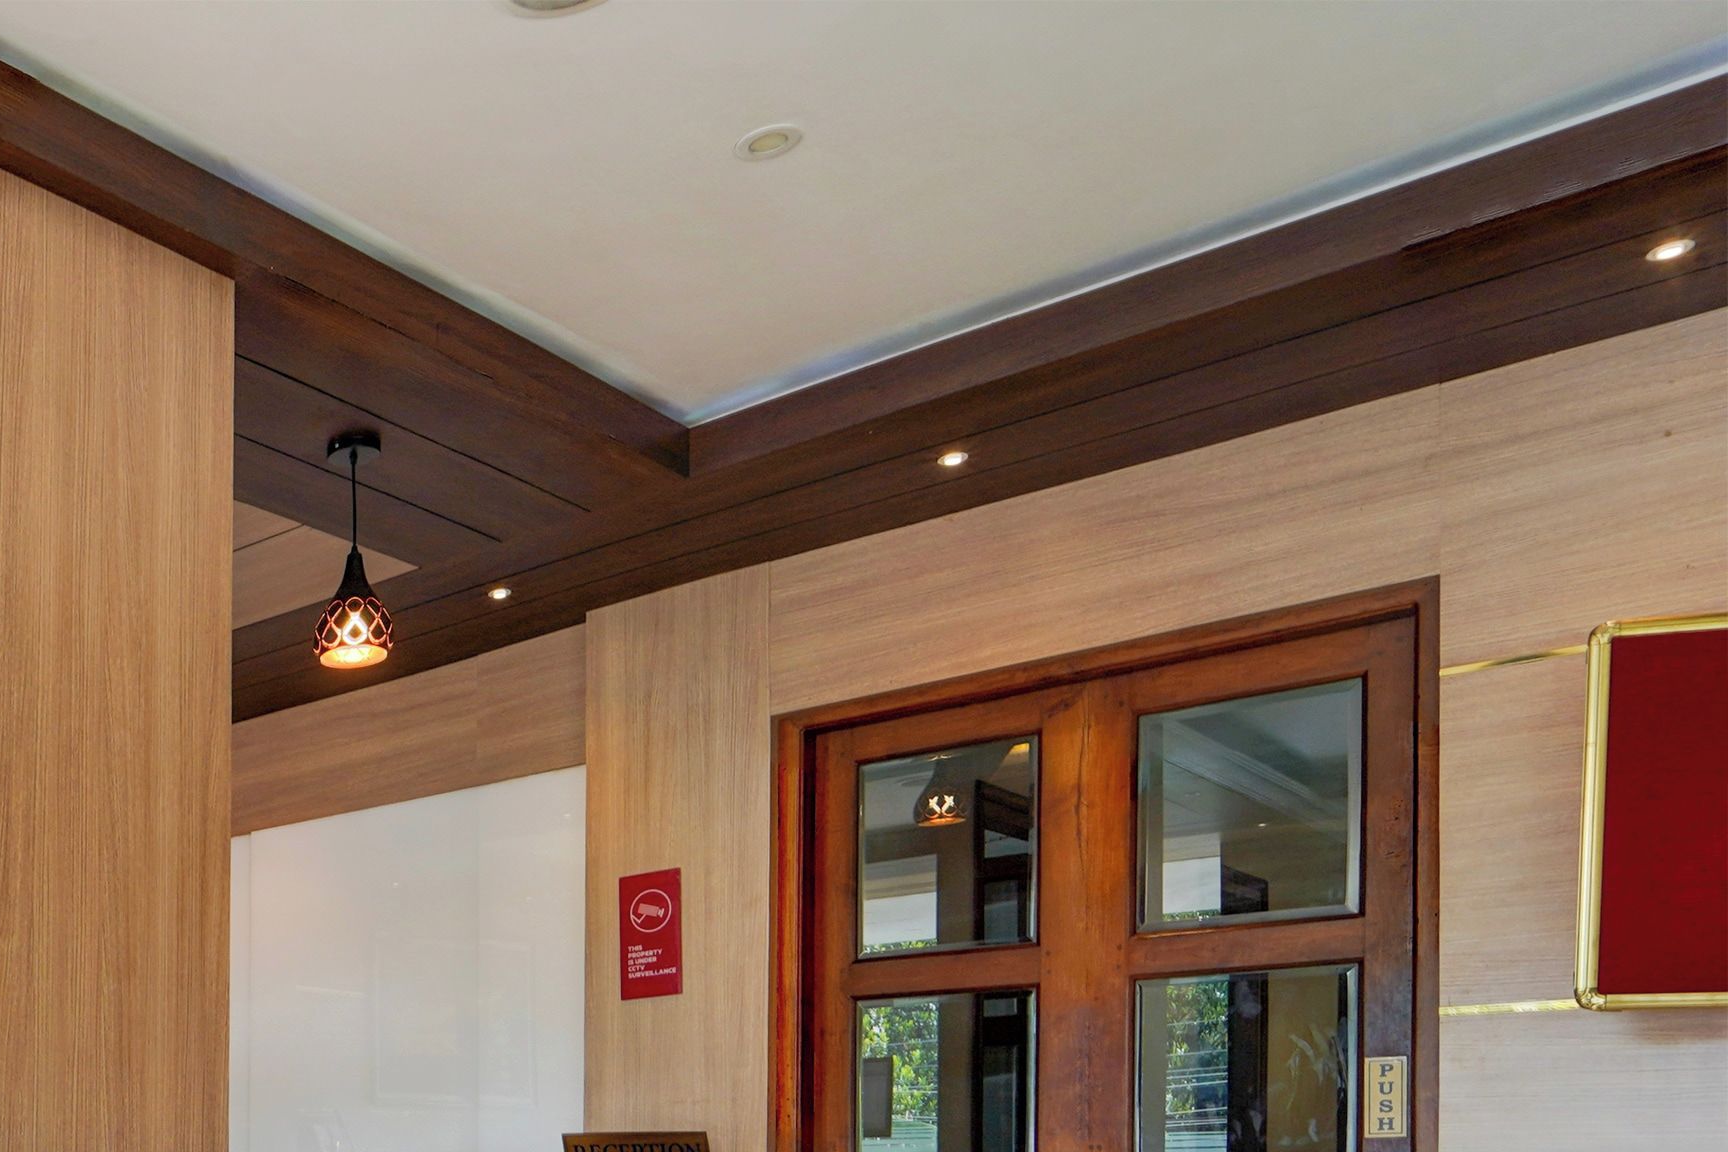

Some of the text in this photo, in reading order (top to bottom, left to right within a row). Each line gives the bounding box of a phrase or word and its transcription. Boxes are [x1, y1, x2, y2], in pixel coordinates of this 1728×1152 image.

[628, 944, 642, 952] THIS
[628, 948, 663, 959] PROPERTY
[635, 956, 657, 965] UNDER
[628, 966, 677, 979] SURVEILLANCE
[1377, 1063, 1395, 1131] PUSH
